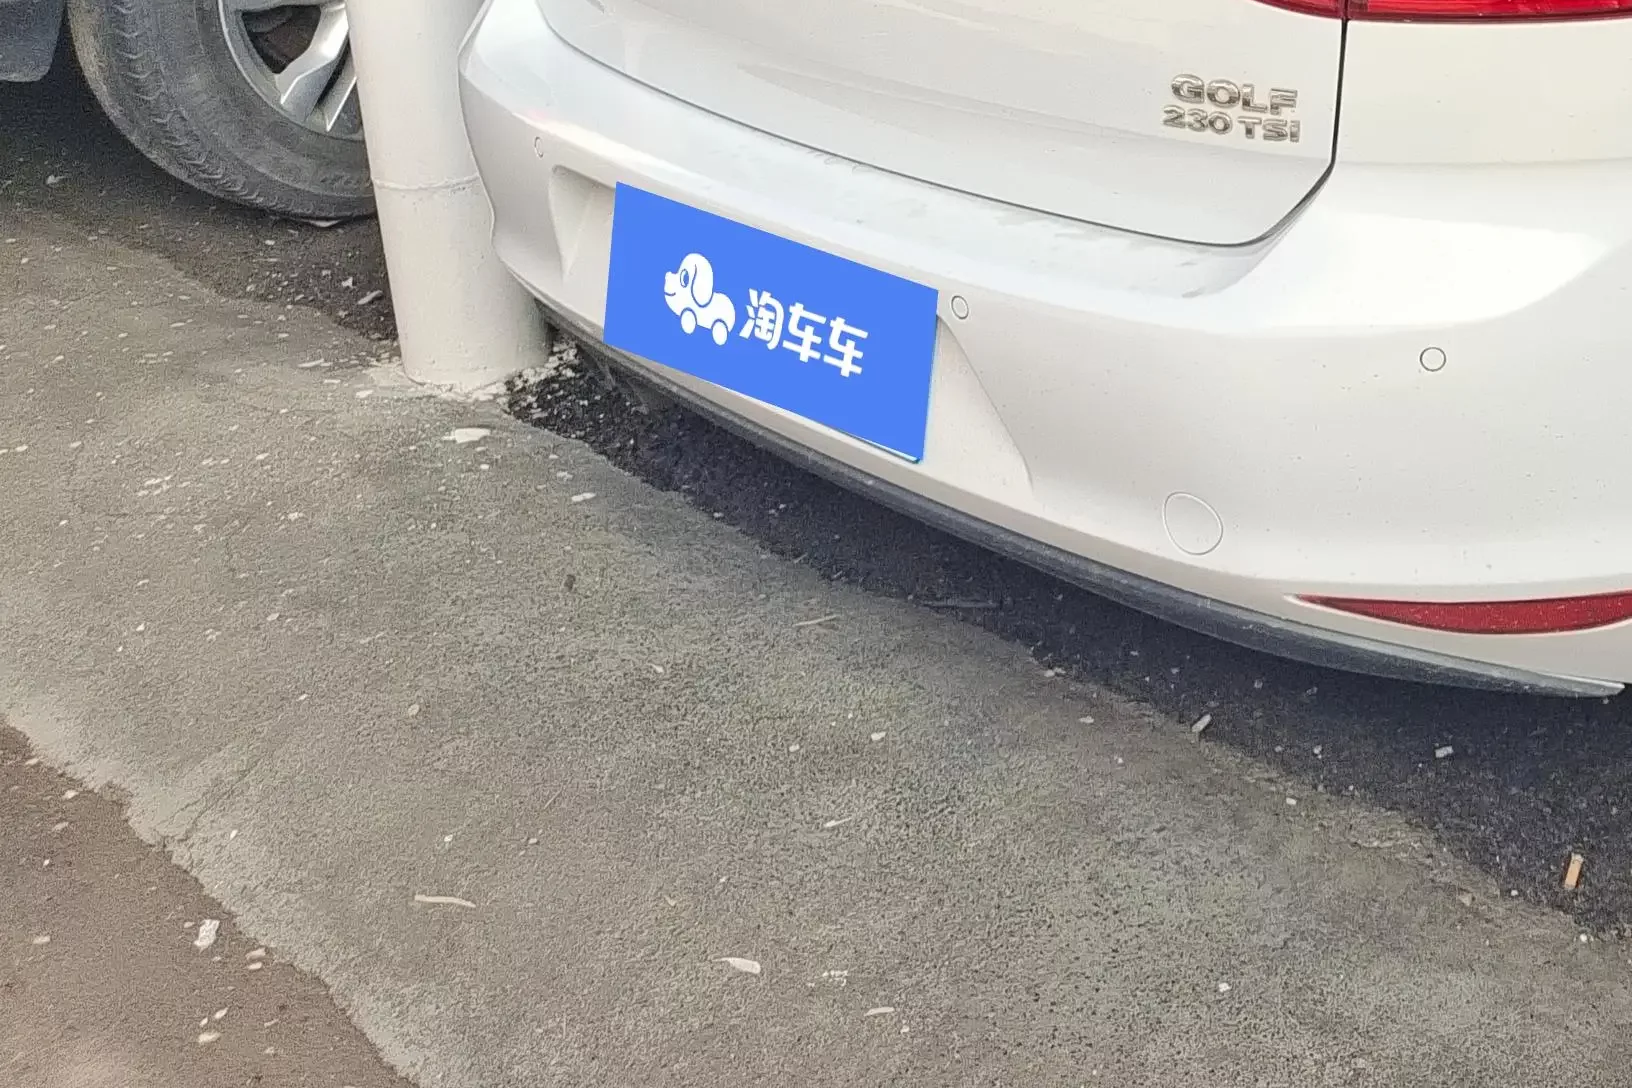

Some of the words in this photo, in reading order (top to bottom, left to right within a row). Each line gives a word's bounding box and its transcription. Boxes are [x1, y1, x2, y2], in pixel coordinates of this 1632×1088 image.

[1171, 74, 1297, 116] GOLF
[1163, 104, 1232, 135] 230
[1237, 115, 1300, 143] TSI
